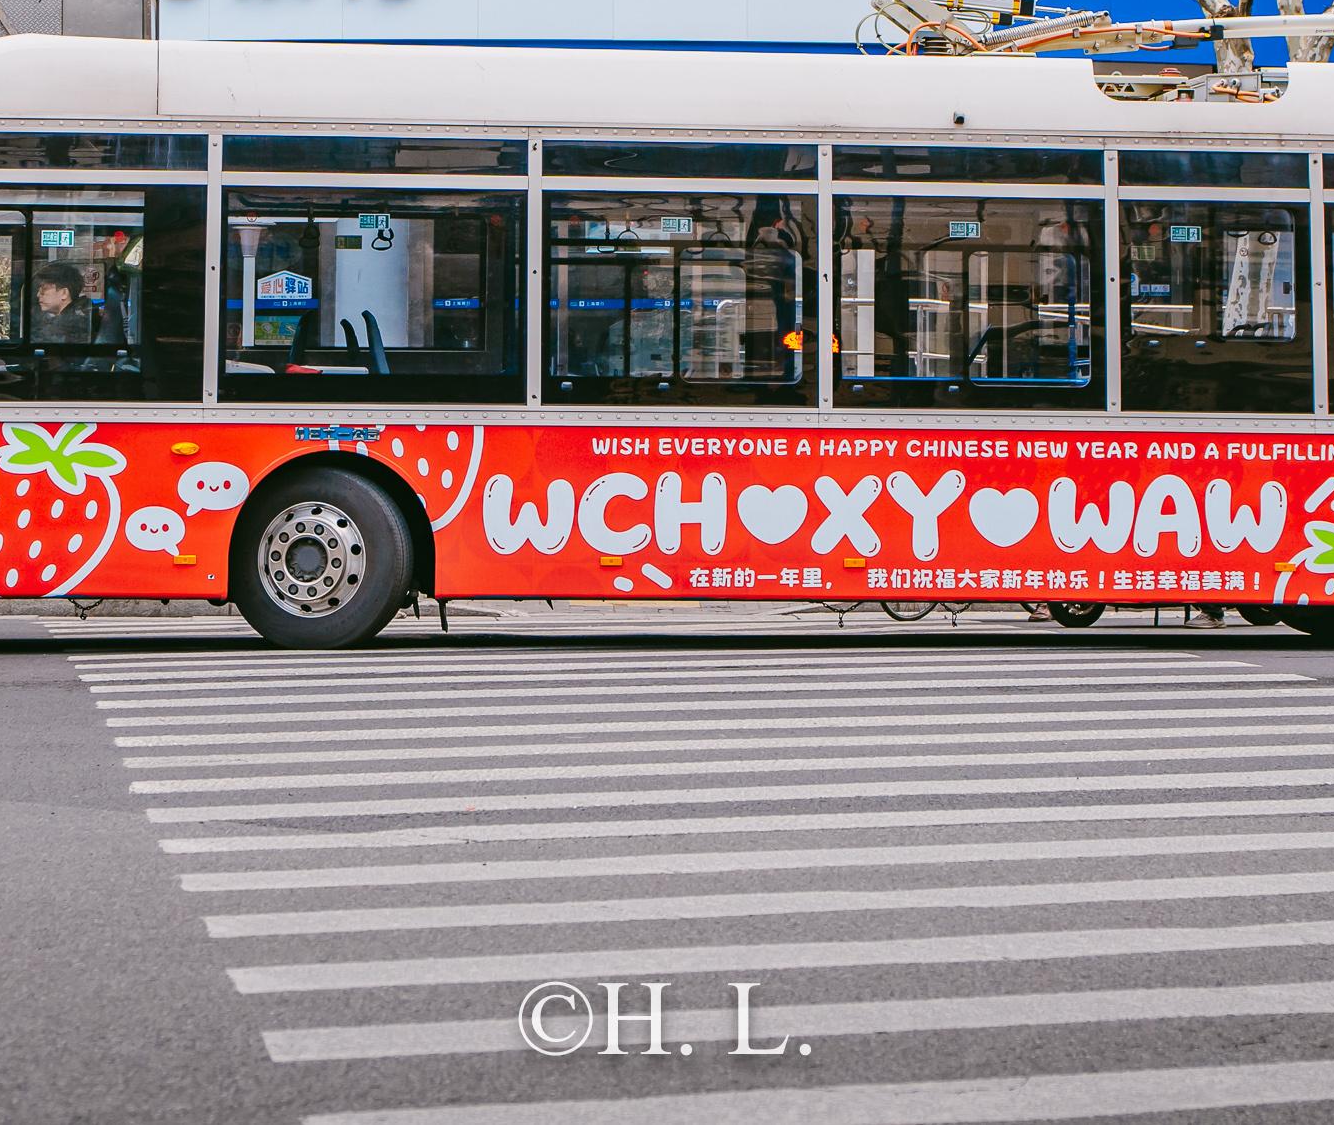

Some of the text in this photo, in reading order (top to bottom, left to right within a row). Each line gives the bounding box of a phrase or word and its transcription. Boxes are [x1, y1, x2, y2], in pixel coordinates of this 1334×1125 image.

[592, 437, 650, 455] WISH
[658, 437, 788, 456] EVERYONE
[796, 438, 812, 456] A
[819, 439, 897, 457] HAPPY
[906, 439, 1009, 458] CHINESE
[1016, 440, 1069, 459] NEW
[1076, 441, 1139, 459] YEAR
[1147, 442, 1197, 460] AND
[1204, 442, 1219, 460] A
[689, 567, 1260, 591] 在新的一年里， 我们祝福大家新年快乐！生活幸福美满！
